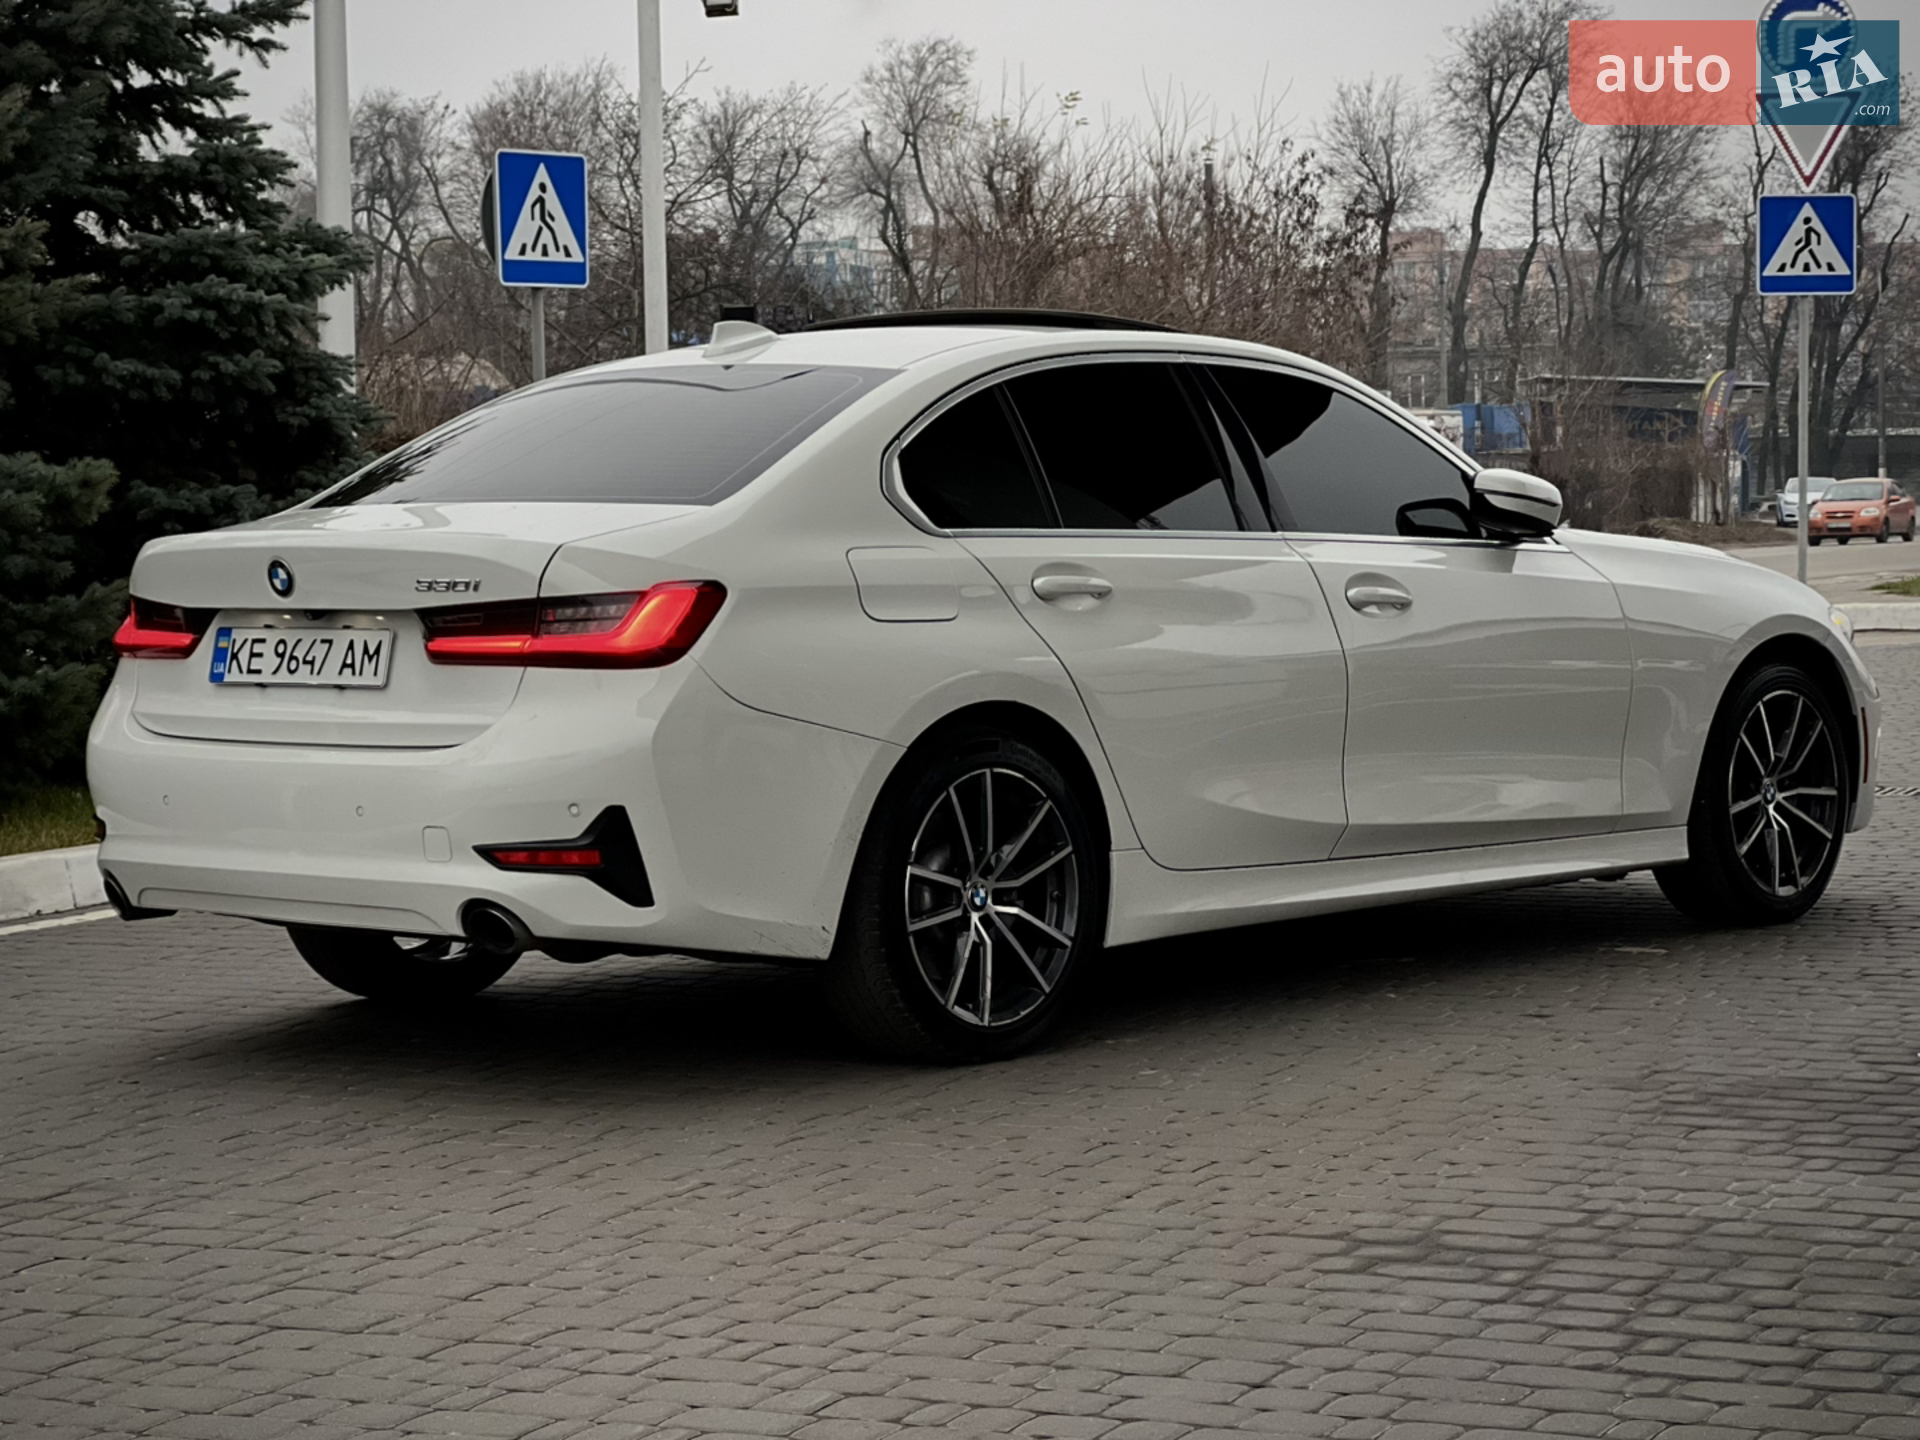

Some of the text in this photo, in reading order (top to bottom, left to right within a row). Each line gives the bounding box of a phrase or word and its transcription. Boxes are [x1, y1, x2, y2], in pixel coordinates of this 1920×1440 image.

[414, 578, 482, 593] 330i
[227, 637, 383, 677] KE 9647 AM
[212, 661, 226, 674] UA
